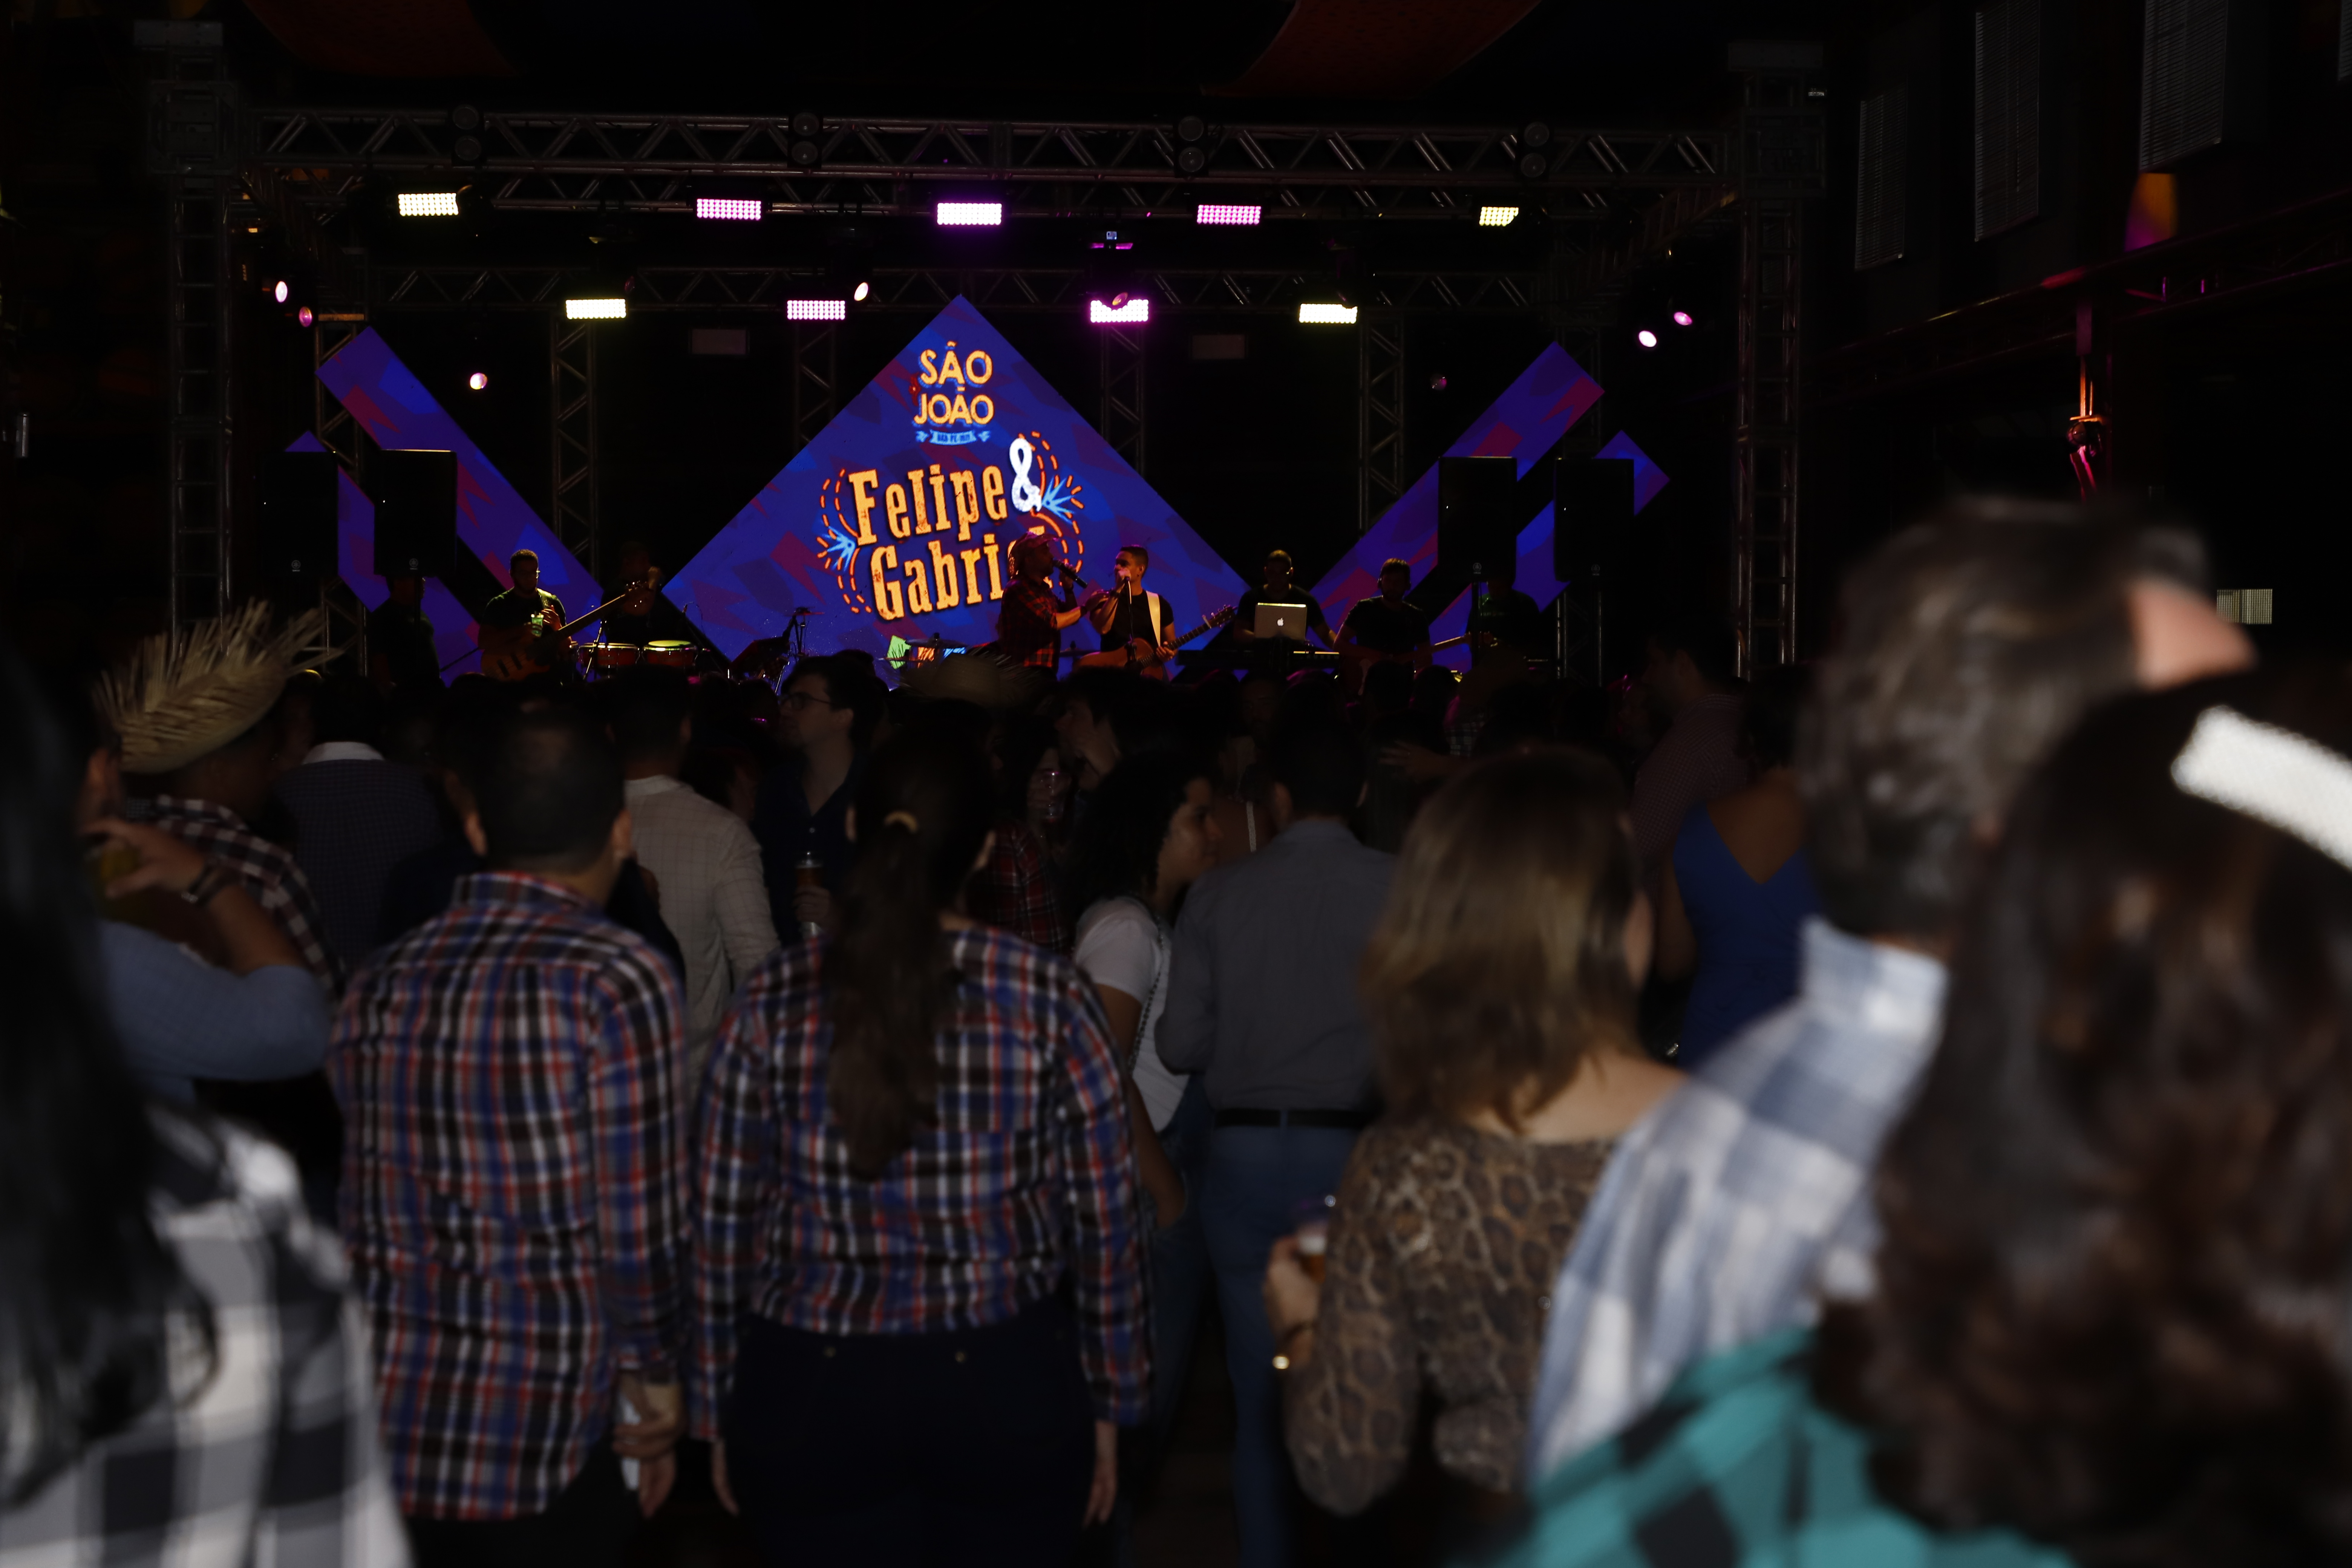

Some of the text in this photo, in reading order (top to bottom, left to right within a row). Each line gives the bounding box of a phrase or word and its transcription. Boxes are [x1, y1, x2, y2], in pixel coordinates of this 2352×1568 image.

[920, 340, 993, 384] SÃO
[914, 386, 994, 424] JOÃO
[848, 438, 1042, 546] Felipe &
[870, 525, 1053, 620] Gabri
